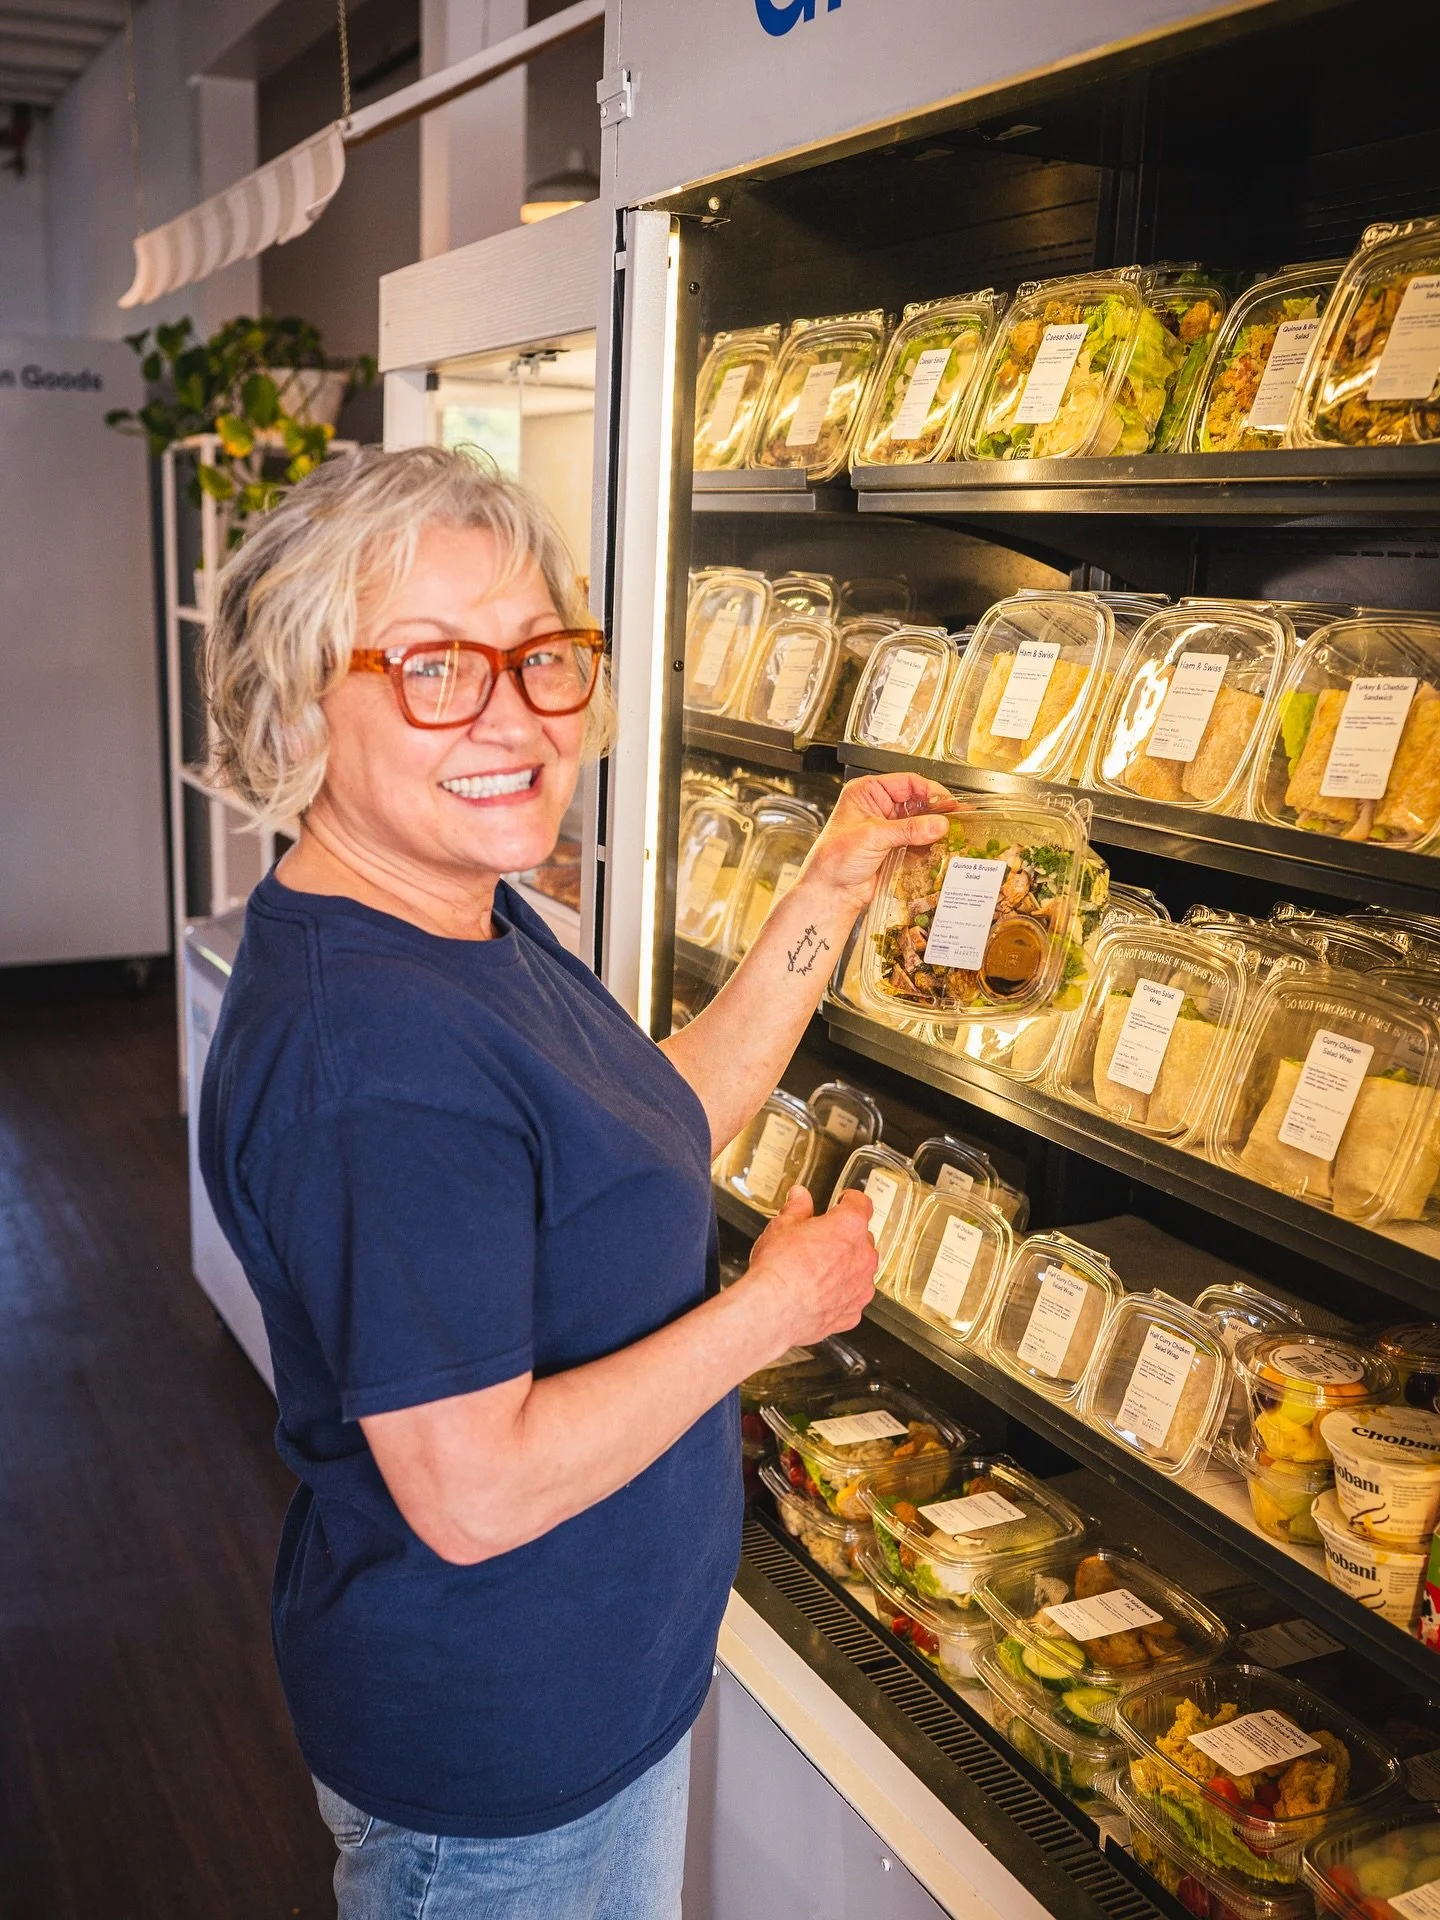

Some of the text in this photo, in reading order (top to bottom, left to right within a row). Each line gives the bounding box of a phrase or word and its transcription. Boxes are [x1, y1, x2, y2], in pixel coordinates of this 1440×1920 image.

[1045, 332, 1082, 342] Caesar Salad
[1283, 324, 1301, 333] Quinoa
[21, 364, 103, 391] Goods
[1019, 649, 1032, 657] Ham
[1037, 650, 1054, 659] Swiss
[1180, 661, 1196, 670] Ham
[1203, 663, 1222, 673] Swiss
[953, 862, 972, 870] Quinoa
[978, 864, 998, 872] Brussel
[965, 872, 980, 880] Salad
[1113, 948, 1123, 958] DO
[1124, 948, 1139, 959] NOT
[1139, 949, 1173, 966] PURCHASE
[1173, 956, 1181, 967] IF
[1143, 984, 1175, 999] Chicken Salad
[1149, 996, 1162, 1006] Wrap
[1285, 999, 1297, 1009] DO
[1298, 1000, 1314, 1010] NOT
[1315, 1001, 1357, 1019] PURCHASE
[1322, 1036, 1362, 1053] Curry Chicken
[1322, 1048, 1354, 1064] Salad Wrap
[1047, 1271, 1084, 1291] Half Curry Chicken
[1228, 1323, 1249, 1335] Half Curr
[1150, 1330, 1191, 1356] Half Curry Chicken
[1154, 1342, 1180, 1360] Salad Wrap
[1351, 1427, 1440, 1453] Choban
[1325, 1542, 1377, 1581] hobani
[1260, 1715, 1303, 1749] Salad Snack Pack
[1270, 1715, 1308, 1744] Curry Chicken
